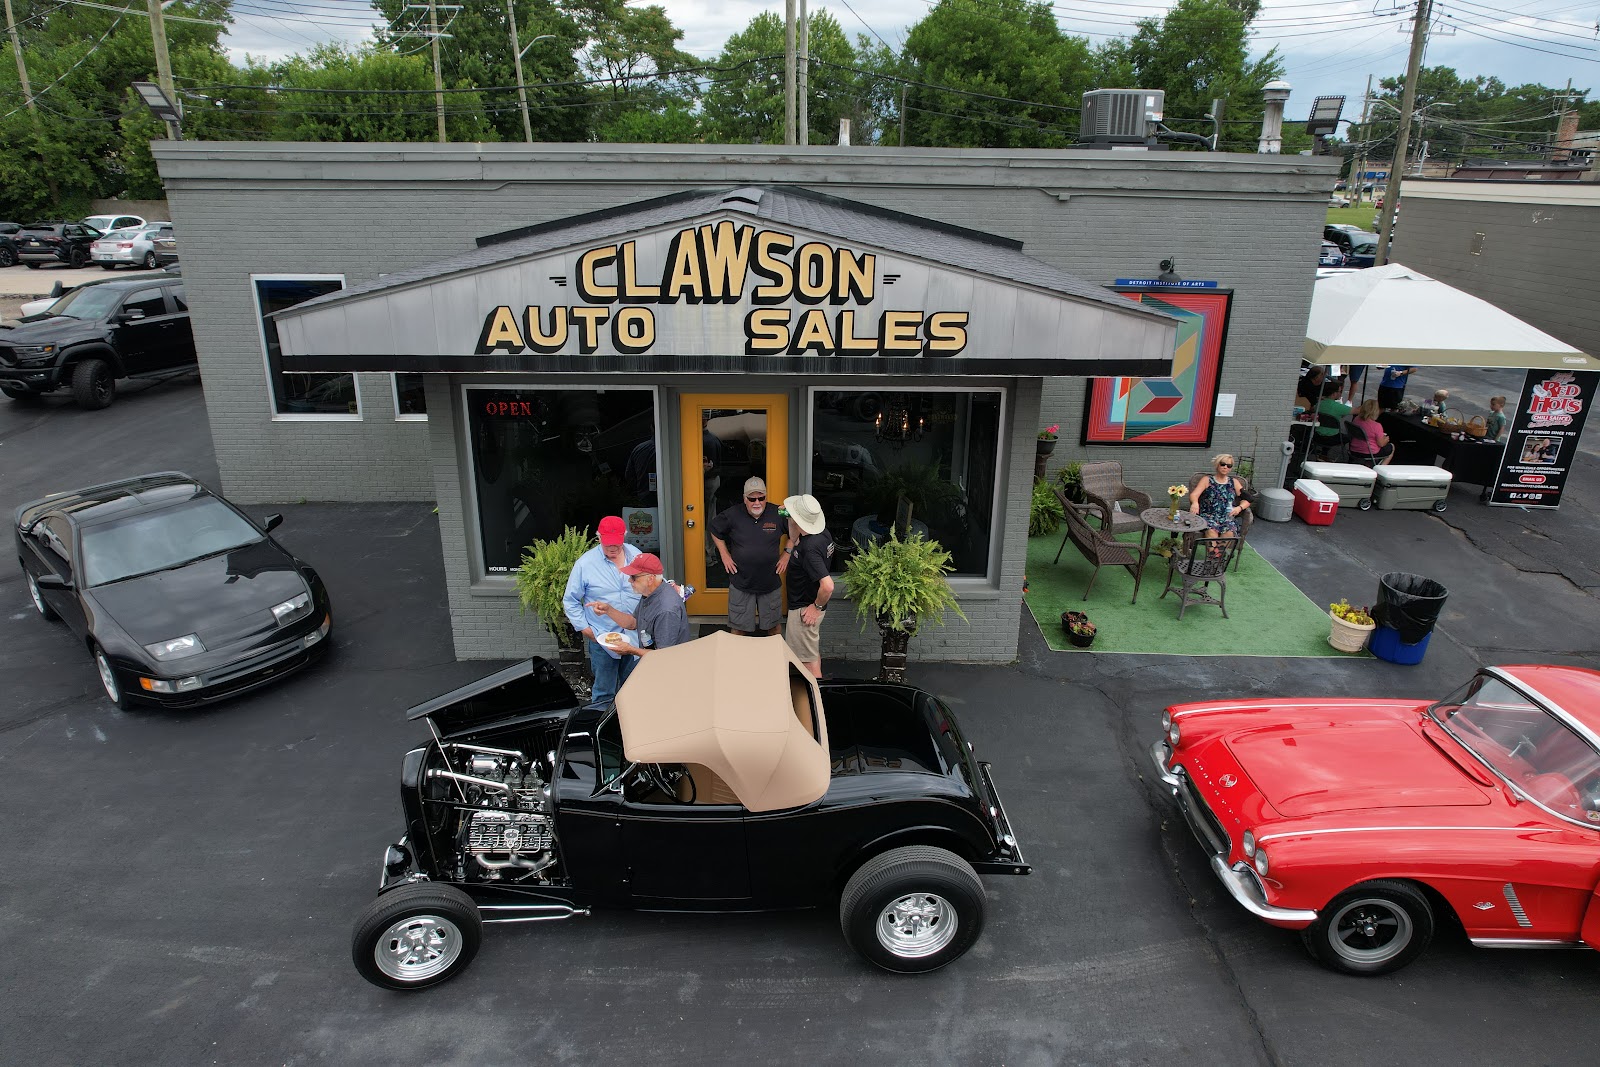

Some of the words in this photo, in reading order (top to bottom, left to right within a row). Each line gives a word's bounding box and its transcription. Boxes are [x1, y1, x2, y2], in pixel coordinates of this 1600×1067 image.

[576, 220, 876, 305] CLAWSON
[475, 305, 656, 354] AUTO
[745, 308, 969, 357] SALES
[486, 401, 531, 416] OPEN
